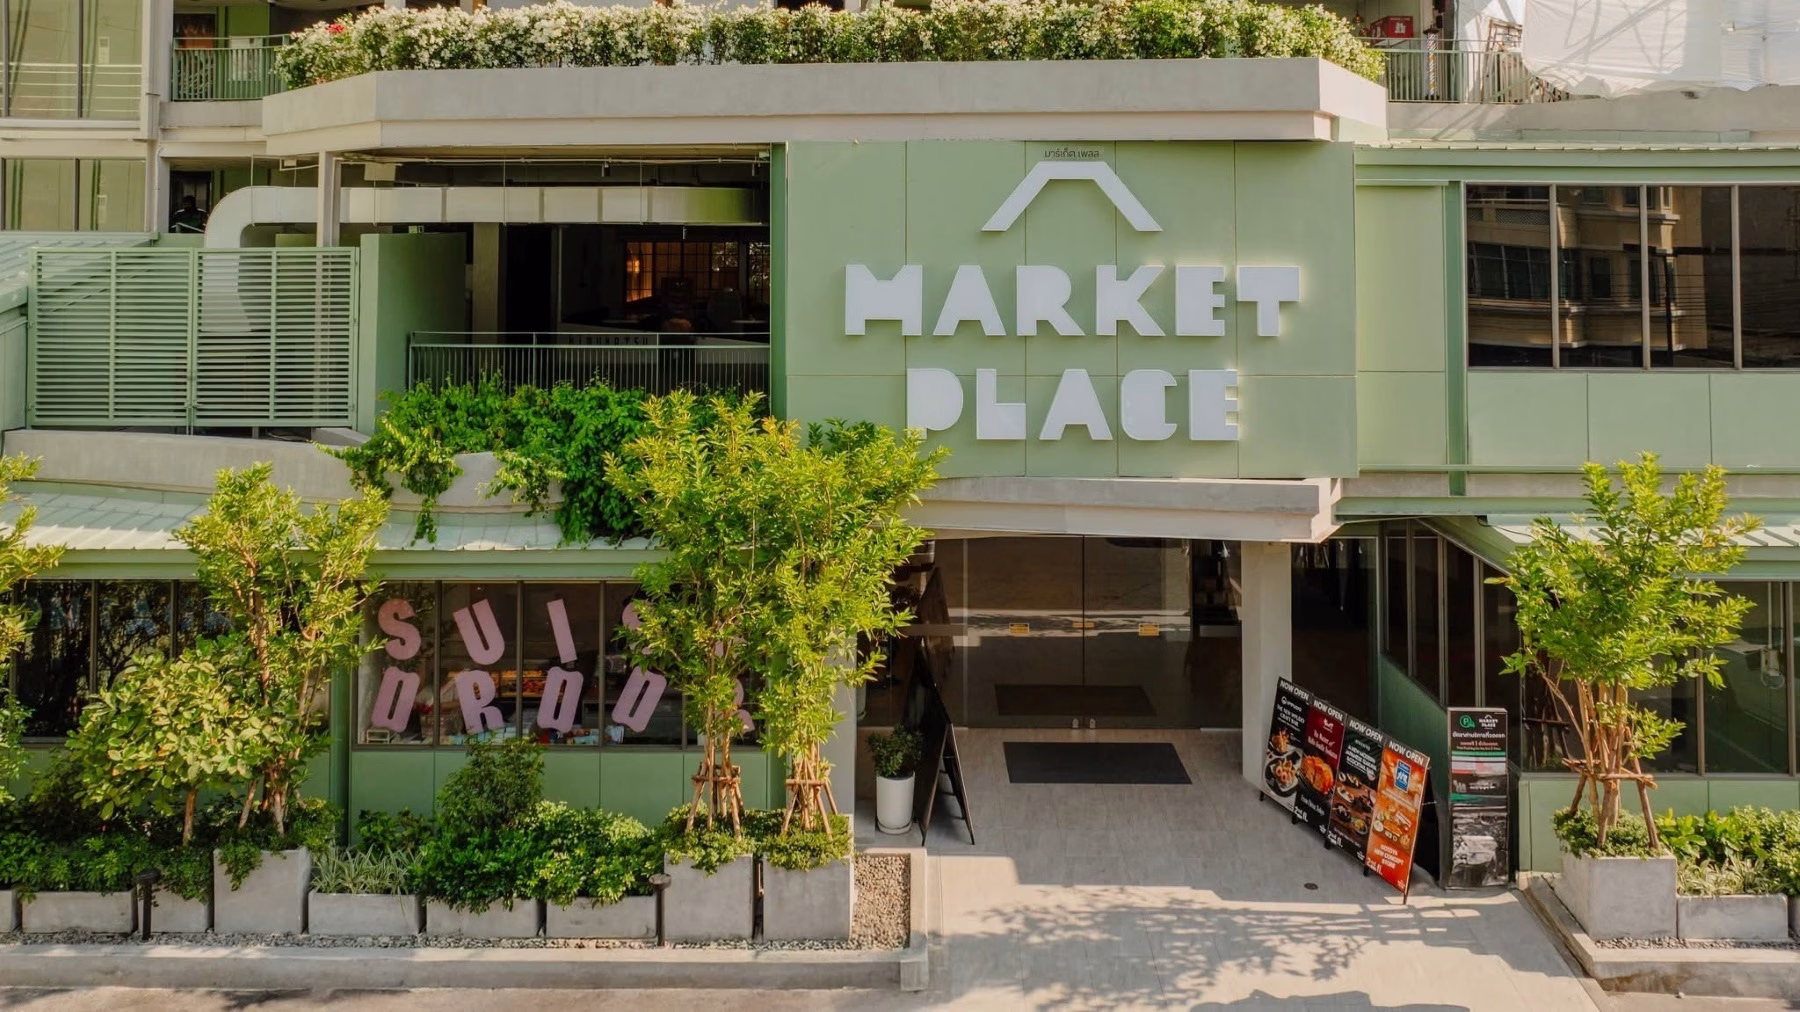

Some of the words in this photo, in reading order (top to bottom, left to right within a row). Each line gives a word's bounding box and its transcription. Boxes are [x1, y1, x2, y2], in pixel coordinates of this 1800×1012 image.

[845, 264, 1300, 337] MARKET
[906, 367, 1239, 441] PLACE
[1280, 680, 1294, 691] NOW
[1294, 687, 1309, 700] OPEN
[1313, 700, 1328, 711] NOW
[1328, 707, 1343, 721] OPEN
[1350, 720, 1365, 733] NOW
[1366, 728, 1383, 742] OPEN
[1389, 741, 1406, 754] NOW
[1406, 751, 1424, 764] OPEN
